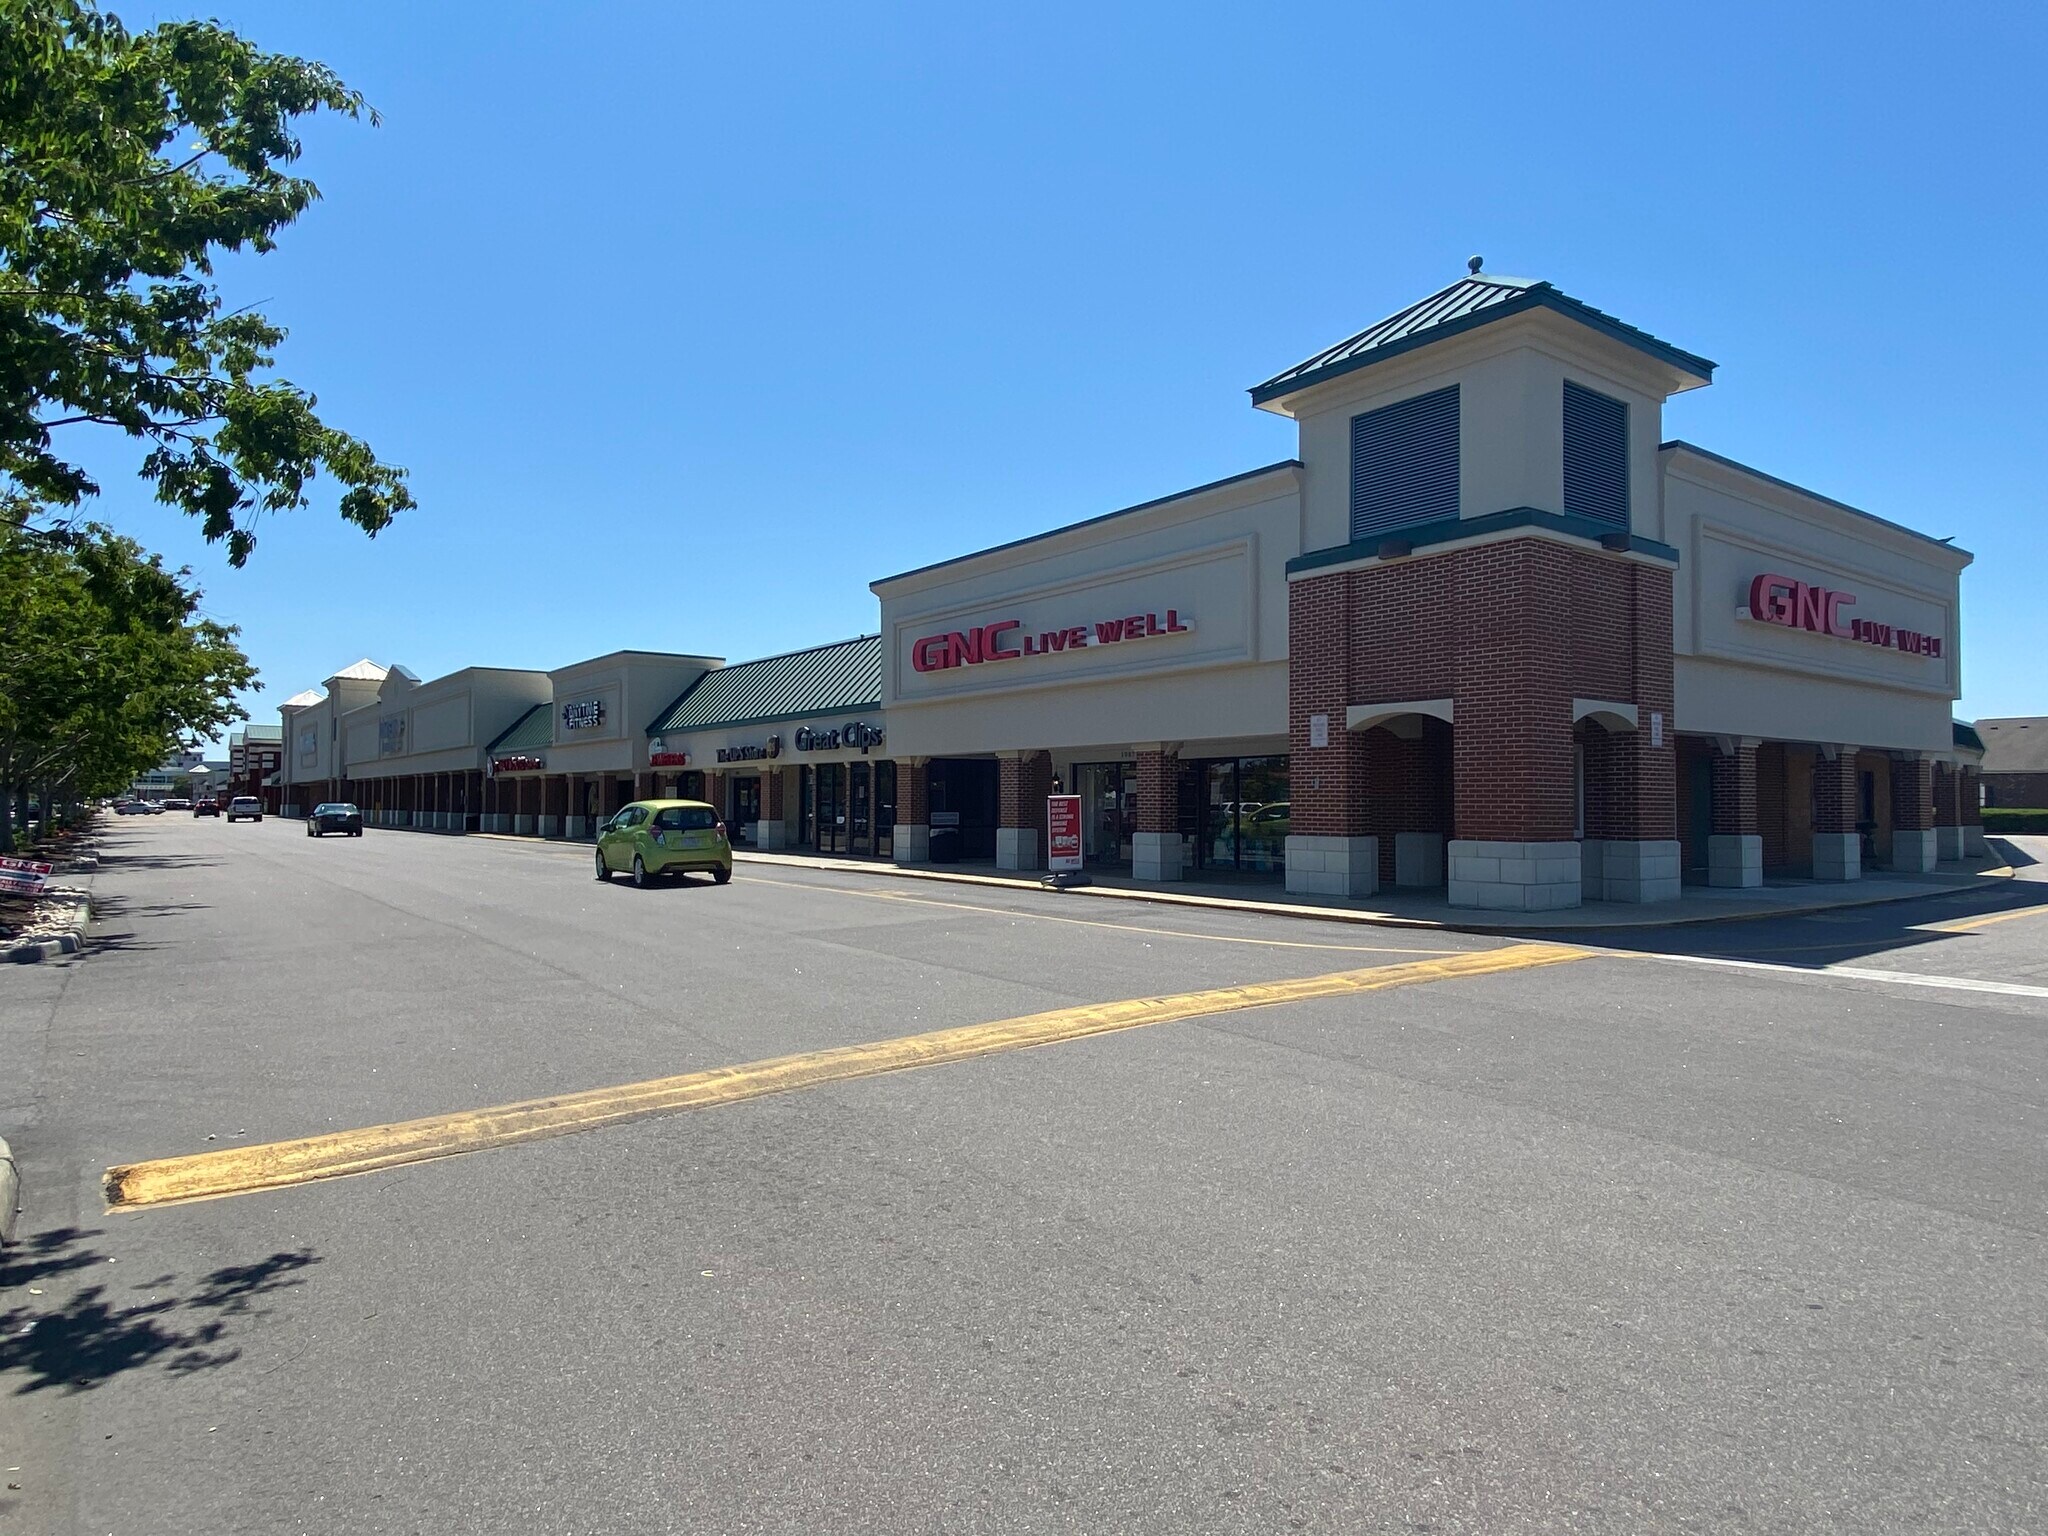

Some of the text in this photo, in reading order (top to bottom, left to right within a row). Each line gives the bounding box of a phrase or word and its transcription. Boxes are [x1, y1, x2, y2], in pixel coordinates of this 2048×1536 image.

[1749, 574, 1857, 639] GNC
[912, 609, 1188, 673] GNC LIVE WELL
[566, 714, 600, 729] FITNESS
[795, 726, 840, 751] Great
[841, 722, 883, 755] Clips
[2, 859, 45, 871] GNC
